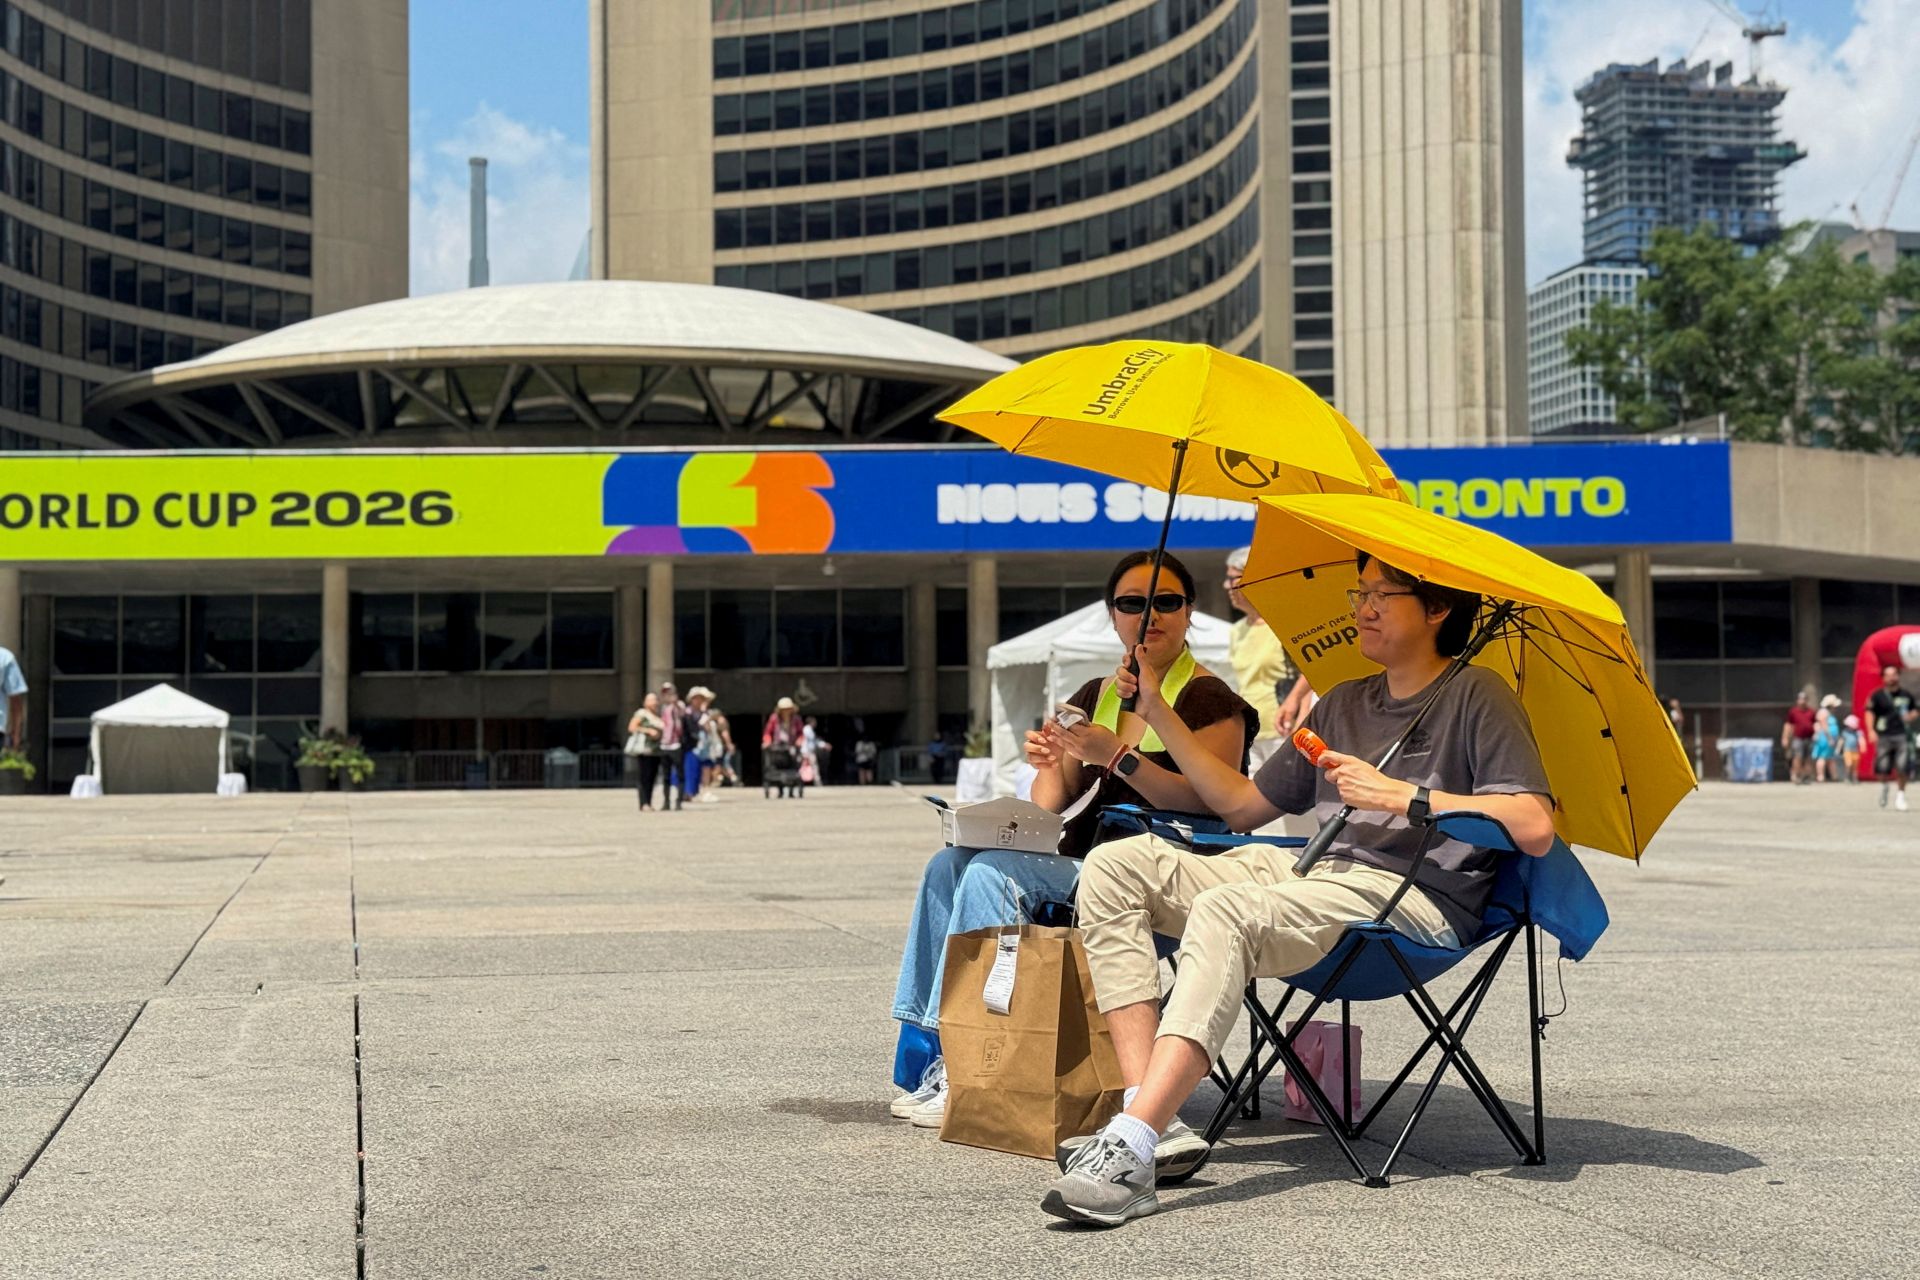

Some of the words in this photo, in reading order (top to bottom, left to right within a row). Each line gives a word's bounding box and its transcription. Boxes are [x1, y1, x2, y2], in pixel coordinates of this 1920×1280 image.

[1082, 348, 1165, 416] UmbraCity
[0, 493, 140, 529] ORLD
[153, 492, 258, 528] CUP
[270, 490, 454, 527] 2026
[1104, 482, 1258, 522] SOMM
[1291, 623, 1327, 644] Borrow.
[1301, 626, 1359, 663] Umb
